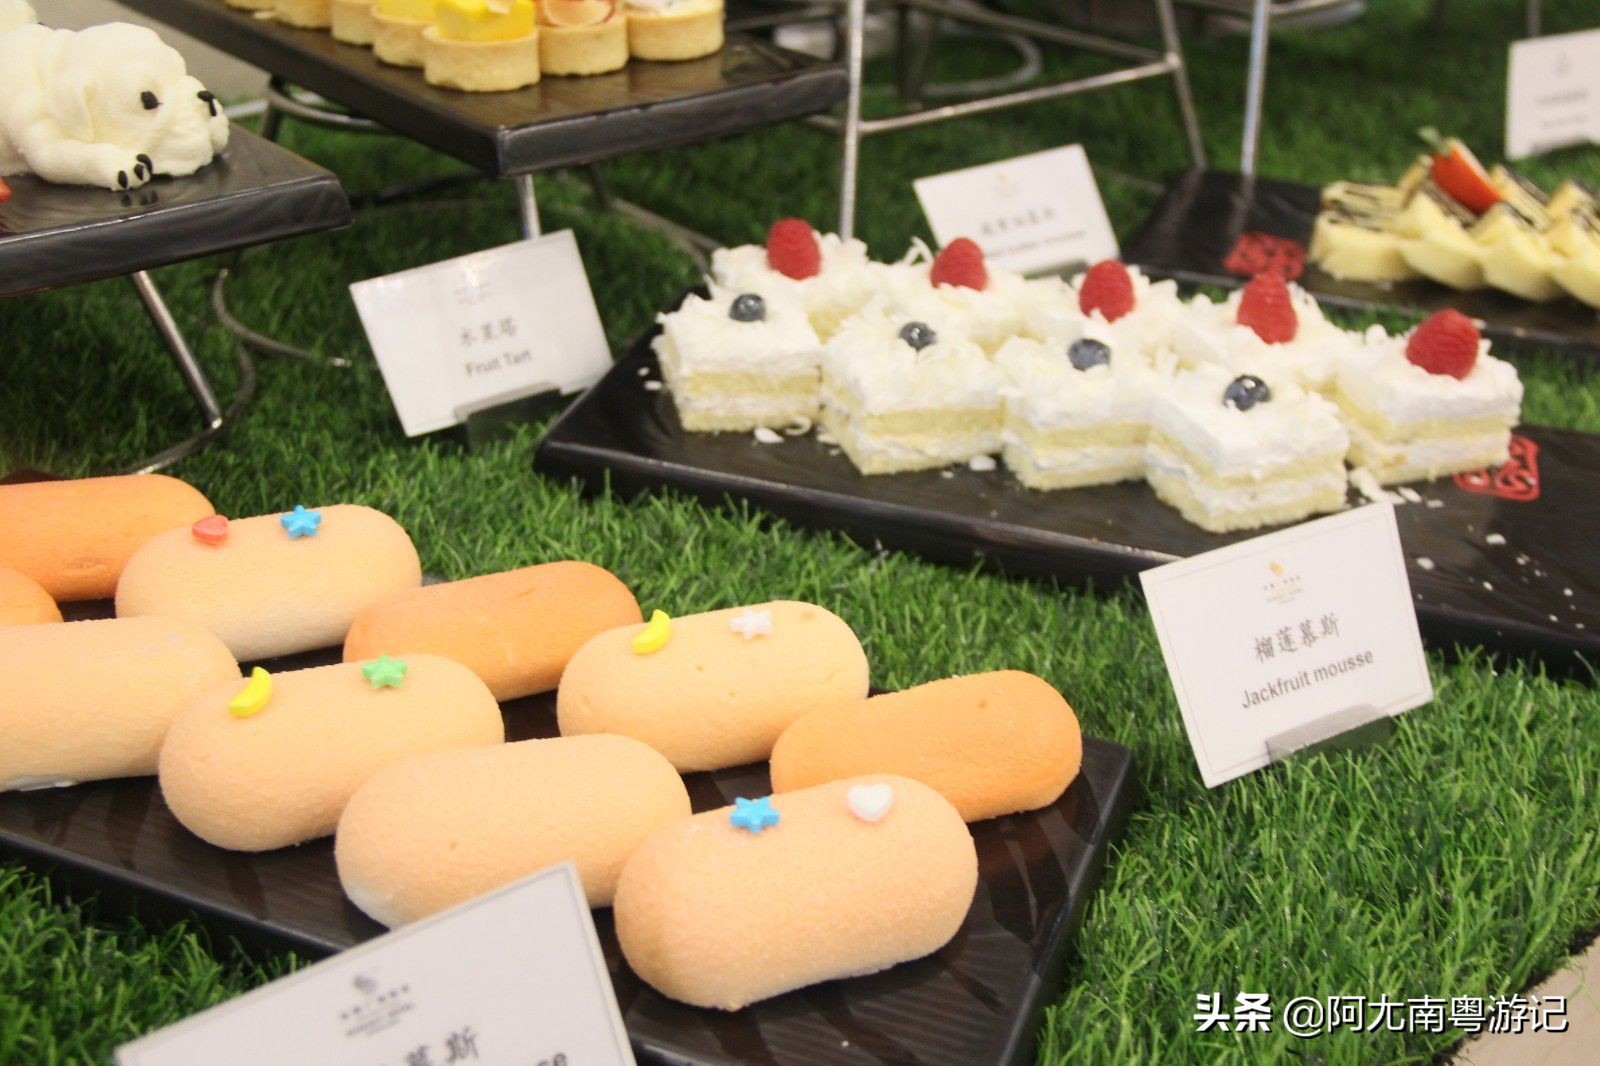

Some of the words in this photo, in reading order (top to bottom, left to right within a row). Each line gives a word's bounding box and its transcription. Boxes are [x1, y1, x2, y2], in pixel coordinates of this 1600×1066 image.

[465, 357, 501, 378] Fruit
[502, 348, 533, 367] Tart
[1254, 613, 1340, 662] 榴莲慕斯
[1243, 671, 1312, 709] Jackfruit
[1314, 650, 1374, 682] mousse
